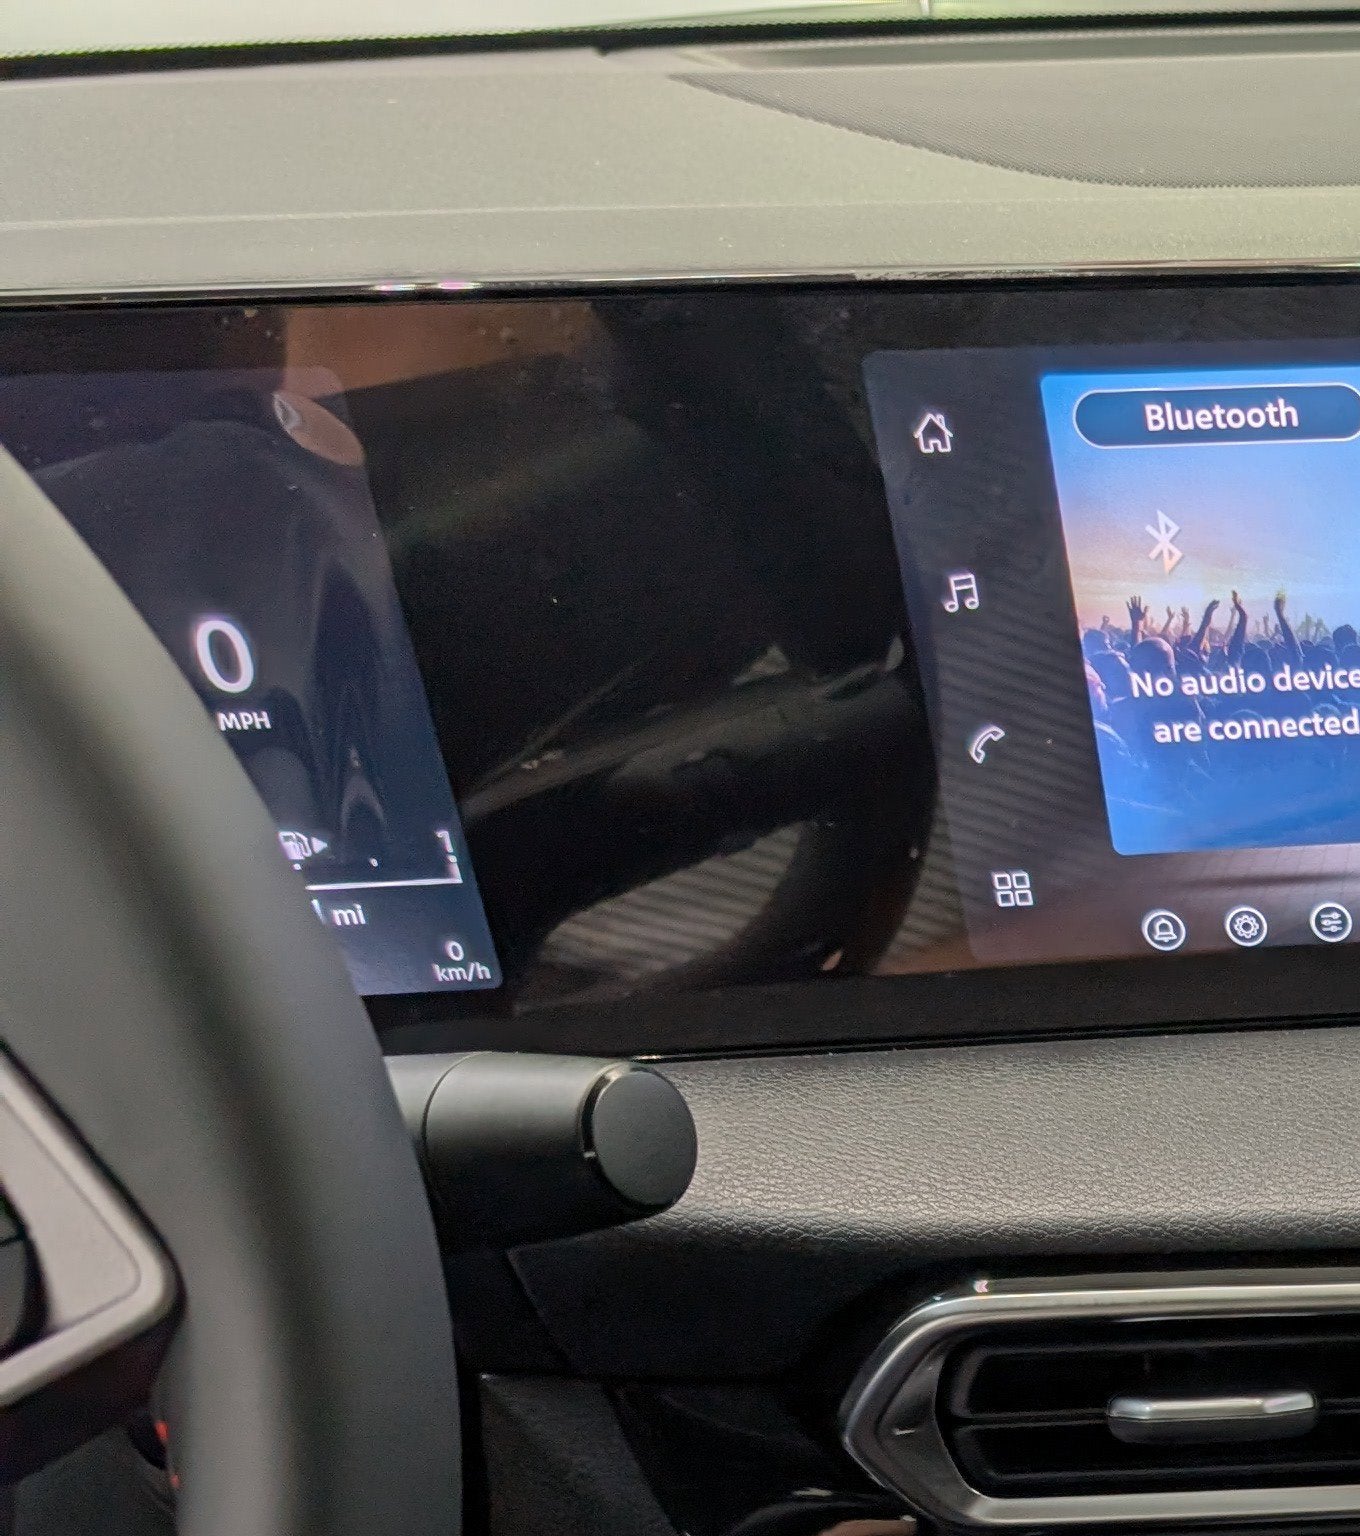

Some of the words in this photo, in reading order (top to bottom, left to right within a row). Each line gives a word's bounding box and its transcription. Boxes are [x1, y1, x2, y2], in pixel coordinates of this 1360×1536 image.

[1144, 398, 1299, 432] Bluetooth
[195, 619, 254, 694] 0
[1130, 671, 1174, 698] No
[1181, 666, 1266, 697] audio
[217, 711, 272, 732] MPH
[1153, 721, 1202, 744] are
[332, 903, 366, 926] mi
[445, 940, 465, 961] 0
[432, 962, 491, 984] km/h
